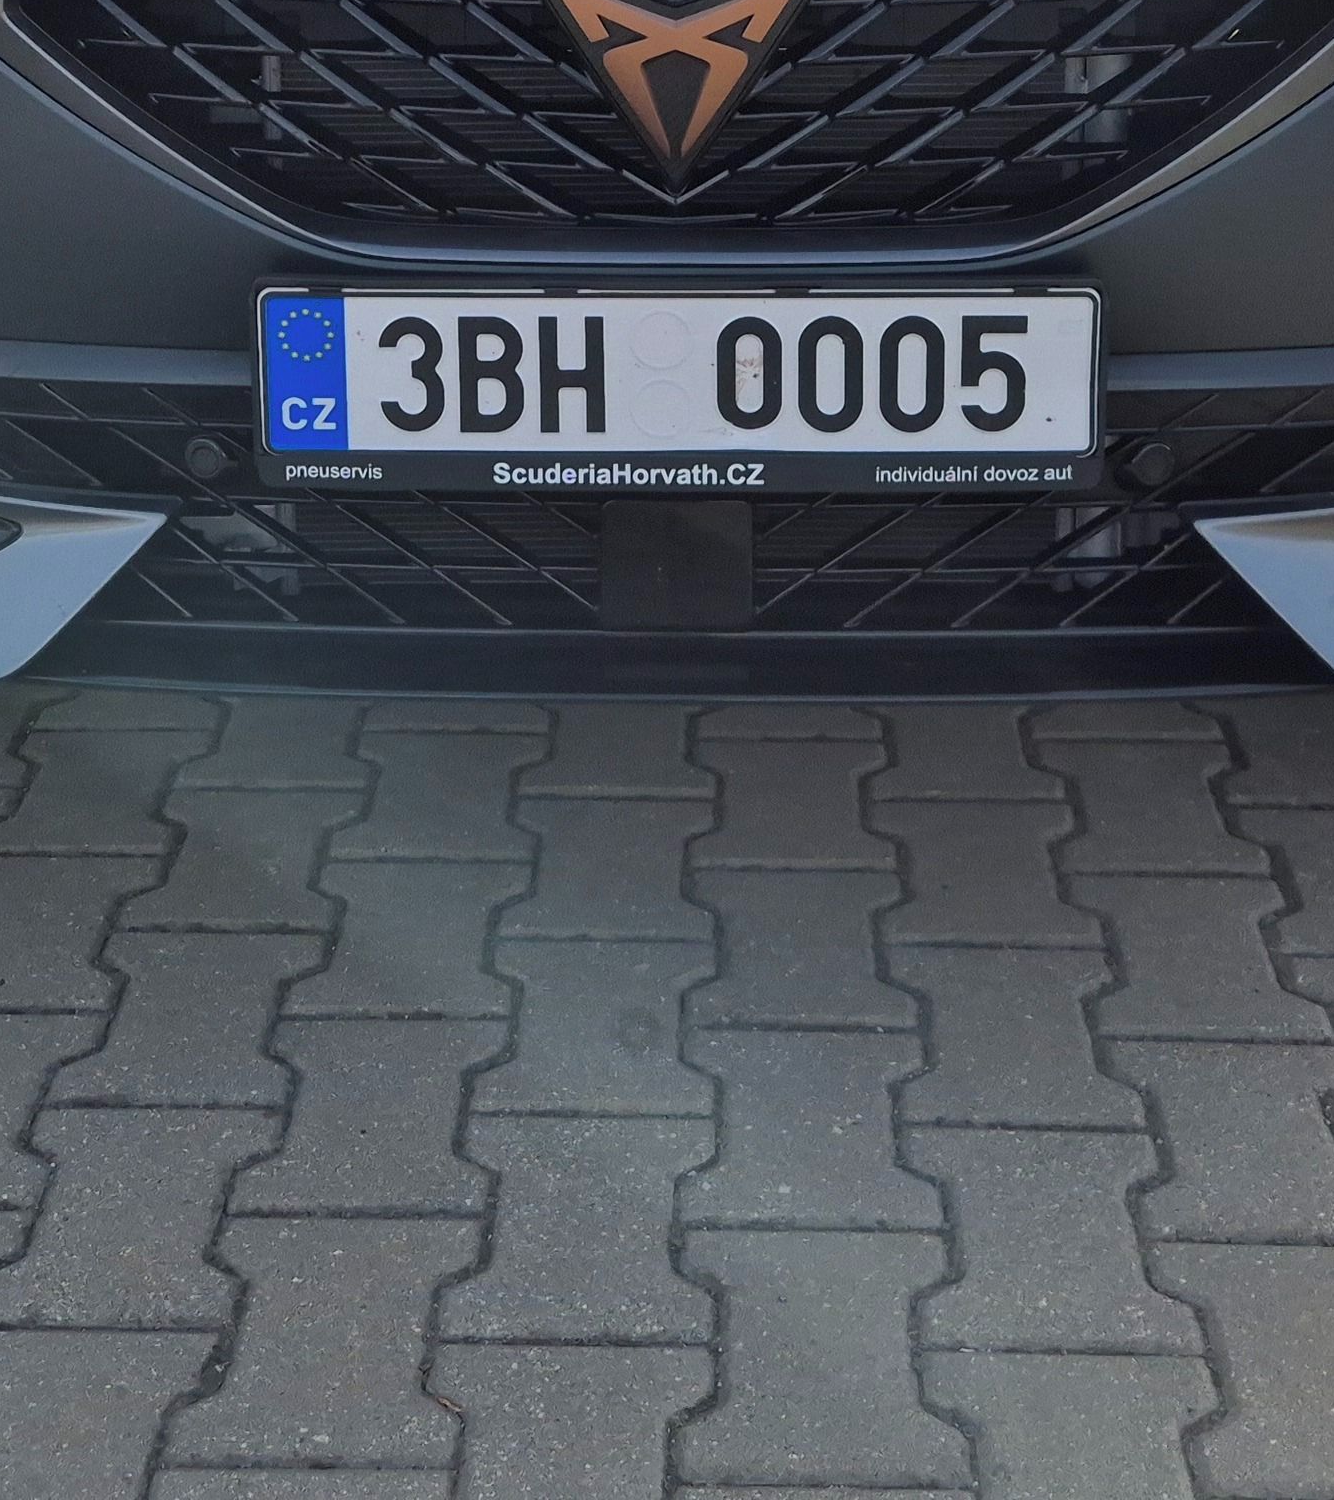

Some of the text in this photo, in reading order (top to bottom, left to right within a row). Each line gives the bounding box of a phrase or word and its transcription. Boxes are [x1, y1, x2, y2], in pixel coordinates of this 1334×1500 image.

[378, 315, 1029, 434] 3BH 0005
[281, 396, 337, 431] CZ
[285, 463, 383, 481] pneuservis
[492, 462, 765, 485] ScuderiaHorvath.CZ
[875, 464, 1073, 483] individuální dovoz aut
